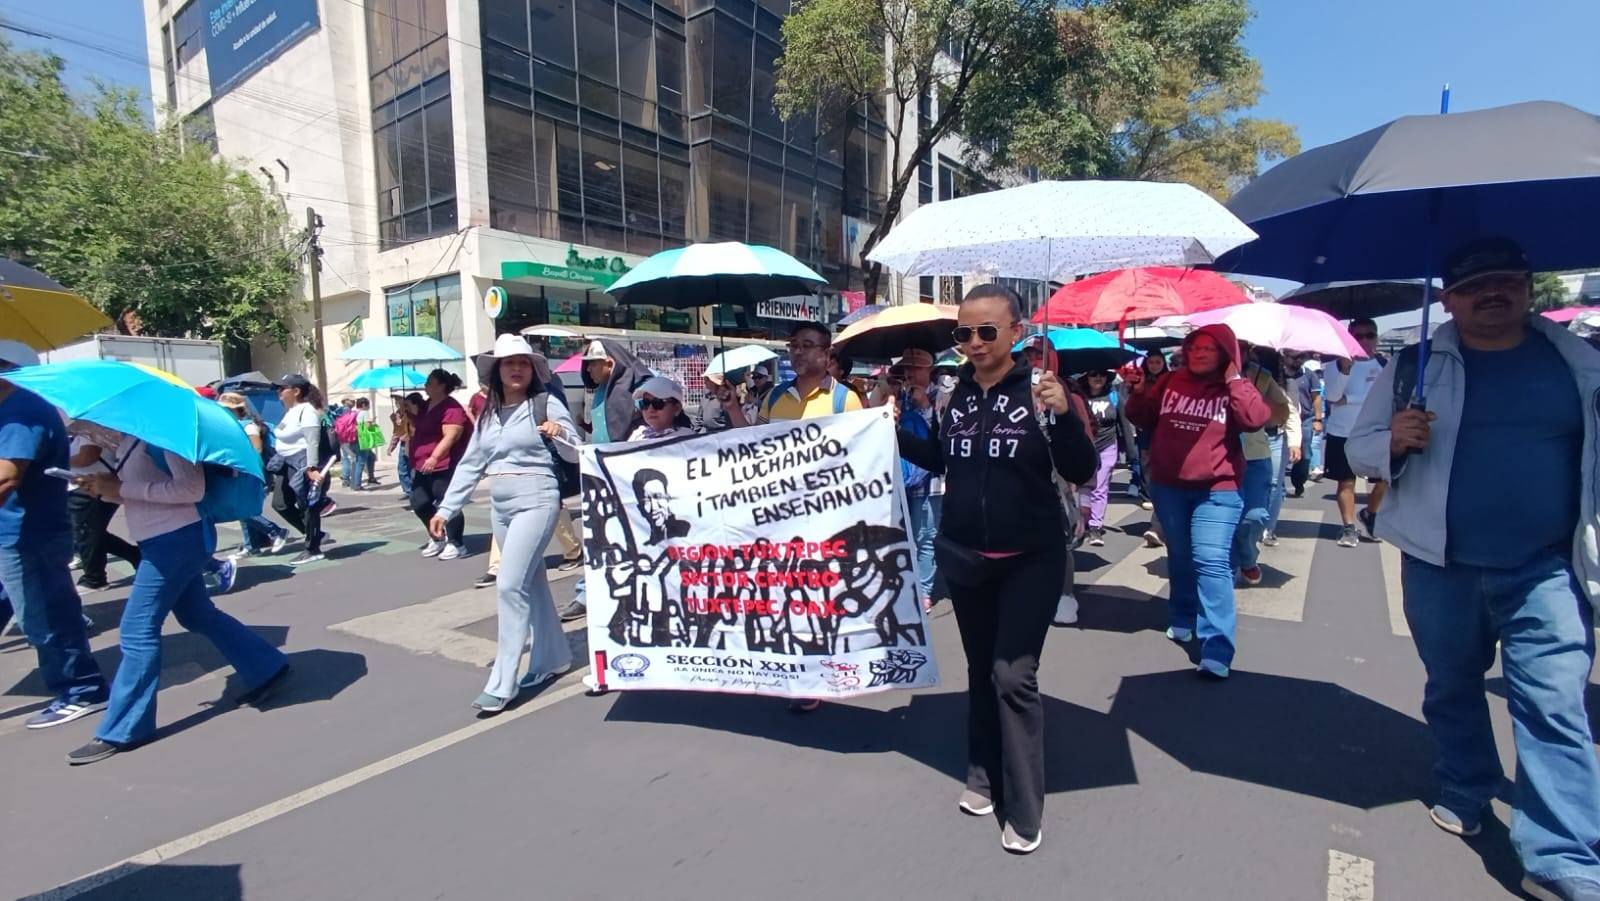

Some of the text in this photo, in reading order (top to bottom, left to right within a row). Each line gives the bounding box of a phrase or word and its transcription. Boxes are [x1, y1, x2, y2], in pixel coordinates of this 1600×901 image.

[759, 301, 801, 318] FRIENDLY
[951, 394, 1029, 423] AERO
[1160, 388, 1229, 425] LE MARAIS
[687, 423, 827, 480] EL MAESTRO,
[950, 438, 1018, 458] 1987
[731, 439, 848, 485] LUCHANDO,
[697, 462, 855, 518] ¡TAMBIEN ESTA
[752, 472, 893, 526] ENSEÑANDO!
[667, 540, 848, 561] REGION TUXTEPEC
[681, 571, 840, 588] SECTOR CENTRO
[791, 599, 846, 618] OAX.
[666, 654, 806, 673] SECCIÓN XXII
